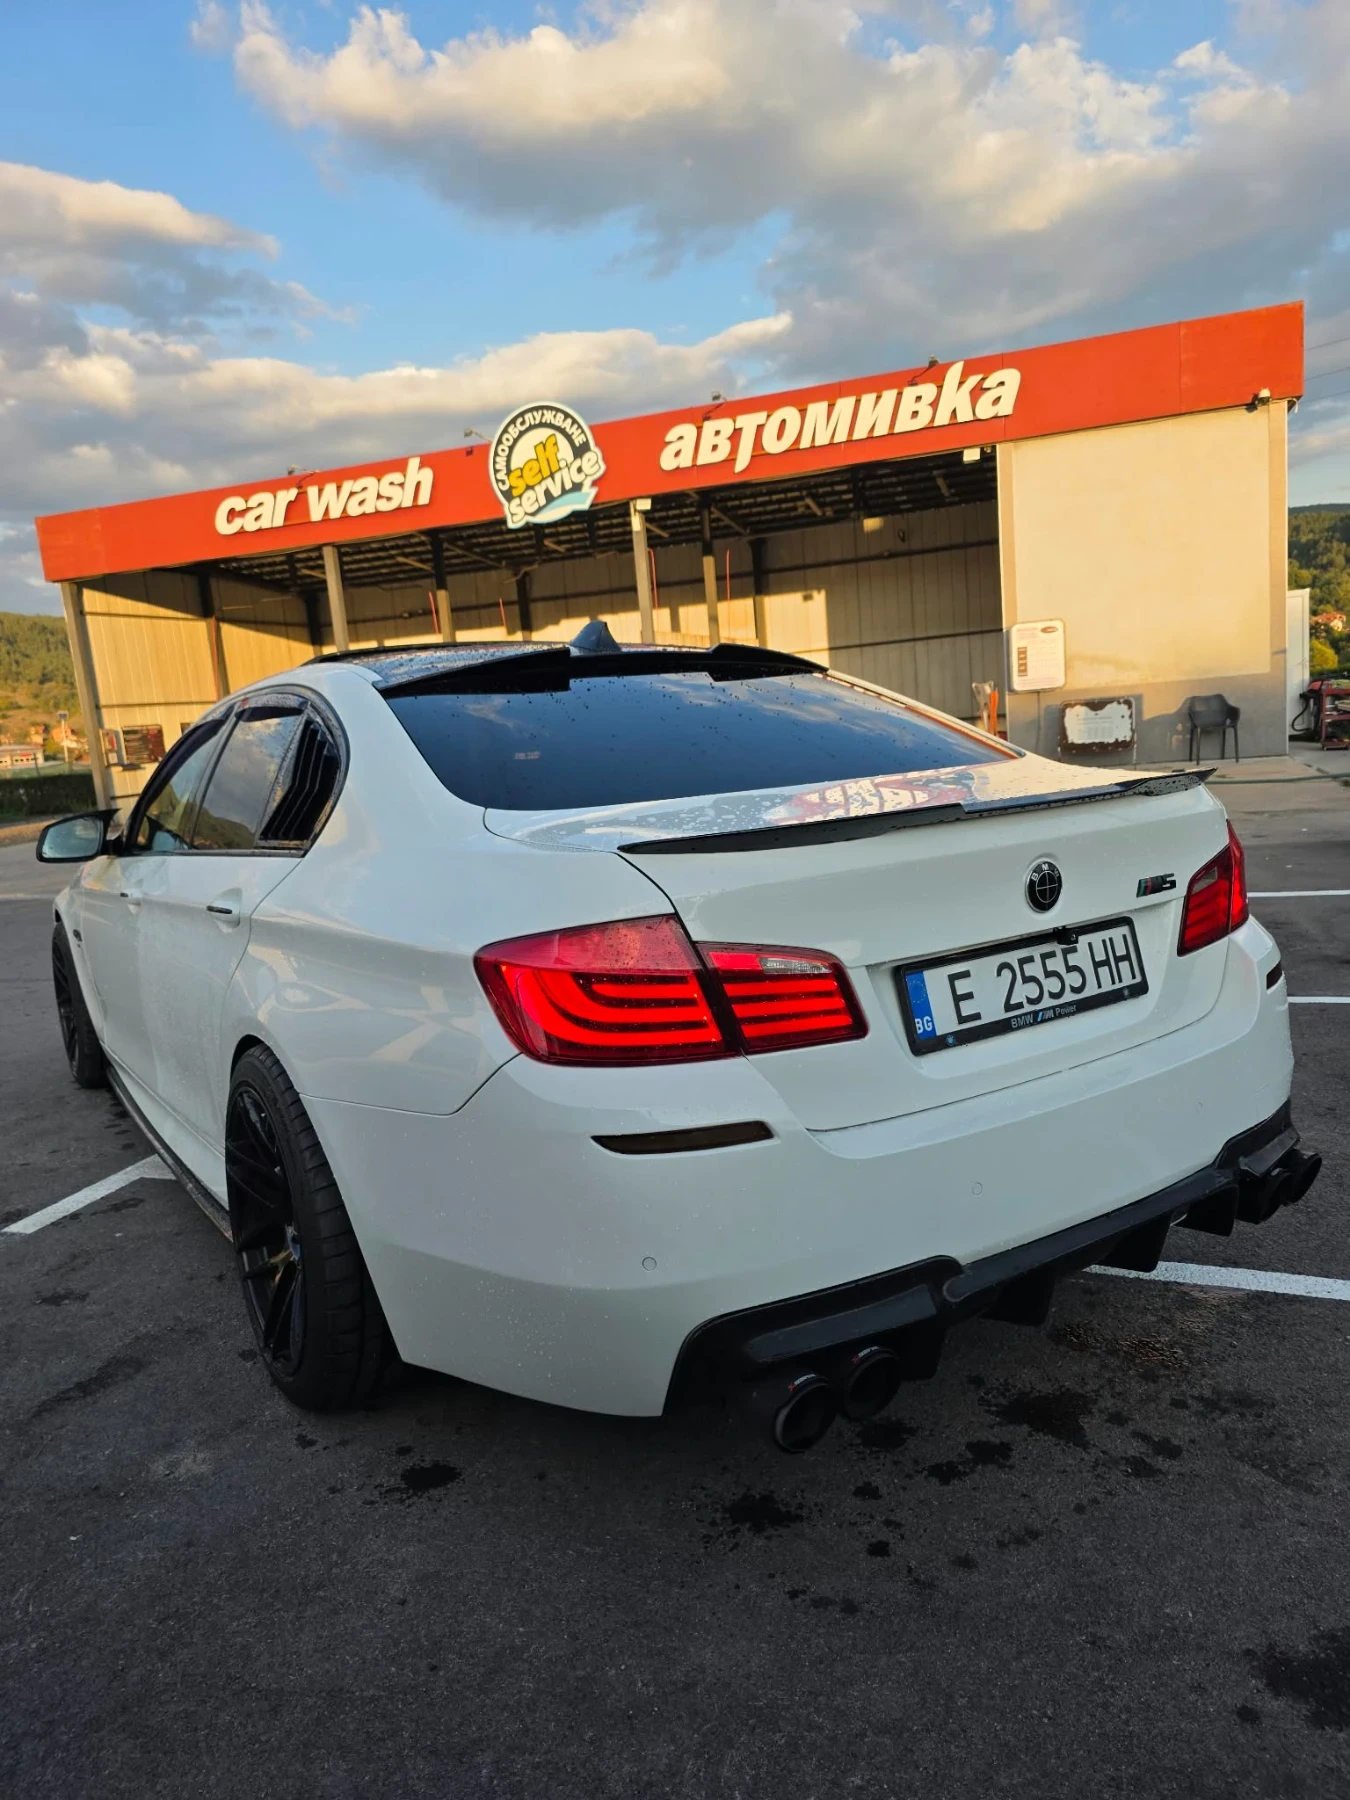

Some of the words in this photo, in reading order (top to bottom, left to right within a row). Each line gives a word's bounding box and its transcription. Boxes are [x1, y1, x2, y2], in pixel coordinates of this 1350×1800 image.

[659, 360, 1021, 473] автомивка
[215, 488, 298, 535] car
[307, 456, 433, 522] wash
[508, 433, 560, 497] self
[508, 450, 601, 524] service
[947, 969, 982, 1025] E
[996, 945, 1087, 1013] 2555
[1011, 1013, 1034, 1028] BMW
[1055, 1004, 1077, 1016] Power
[915, 1017, 933, 1034] BG
